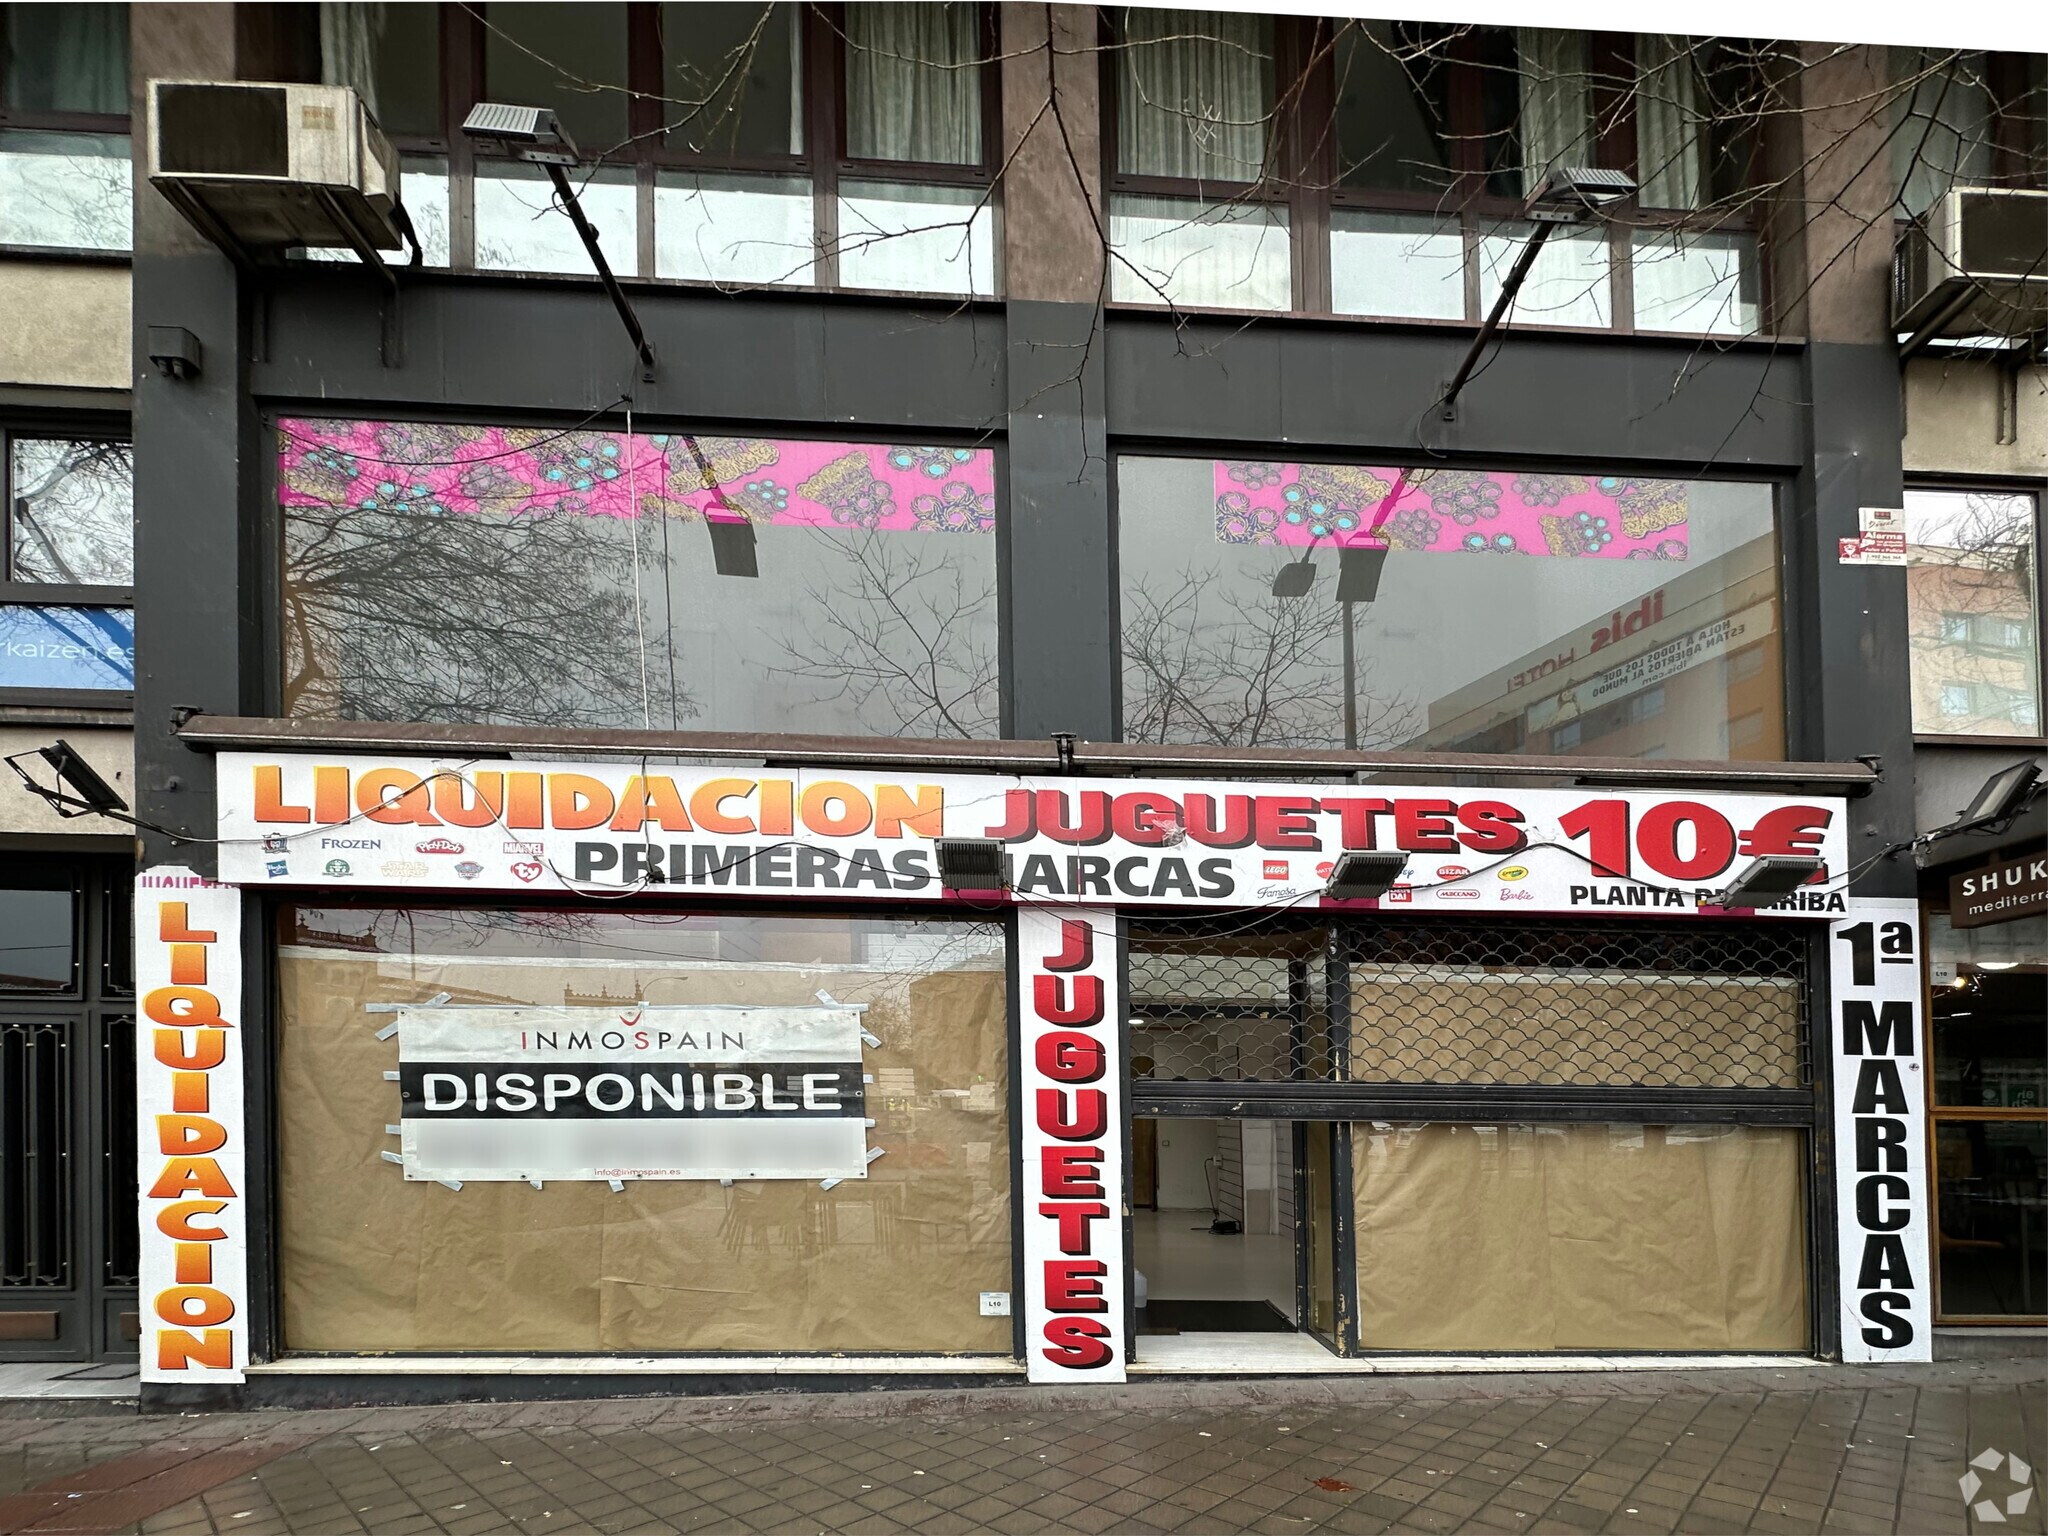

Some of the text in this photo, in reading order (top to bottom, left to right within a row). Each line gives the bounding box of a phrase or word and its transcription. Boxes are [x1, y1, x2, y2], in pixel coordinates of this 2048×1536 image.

[1864, 532, 1903, 540] Alarma
[252, 765, 945, 840] LIQUIDACION
[984, 788, 1527, 854] JUGUETES
[321, 838, 381, 850] FROZEN
[1556, 799, 1834, 886] 10€
[574, 841, 1236, 899] PRIMERAS ARCAS
[1264, 866, 1288, 875] LEGO
[1257, 884, 1297, 899] Famosa
[1499, 888, 1535, 901] Barbie
[1569, 885, 1686, 908] PLANTA
[521, 1030, 746, 1052] INMOSPAIN
[421, 1072, 843, 1113] DISPONIBLE
[141, 901, 238, 1370] LIQUIDACION
[1033, 919, 1114, 1370] JUGUETES
[594, 1167, 681, 1178] info@inmospain.es
[1842, 1000, 1916, 1349] MARCAS
